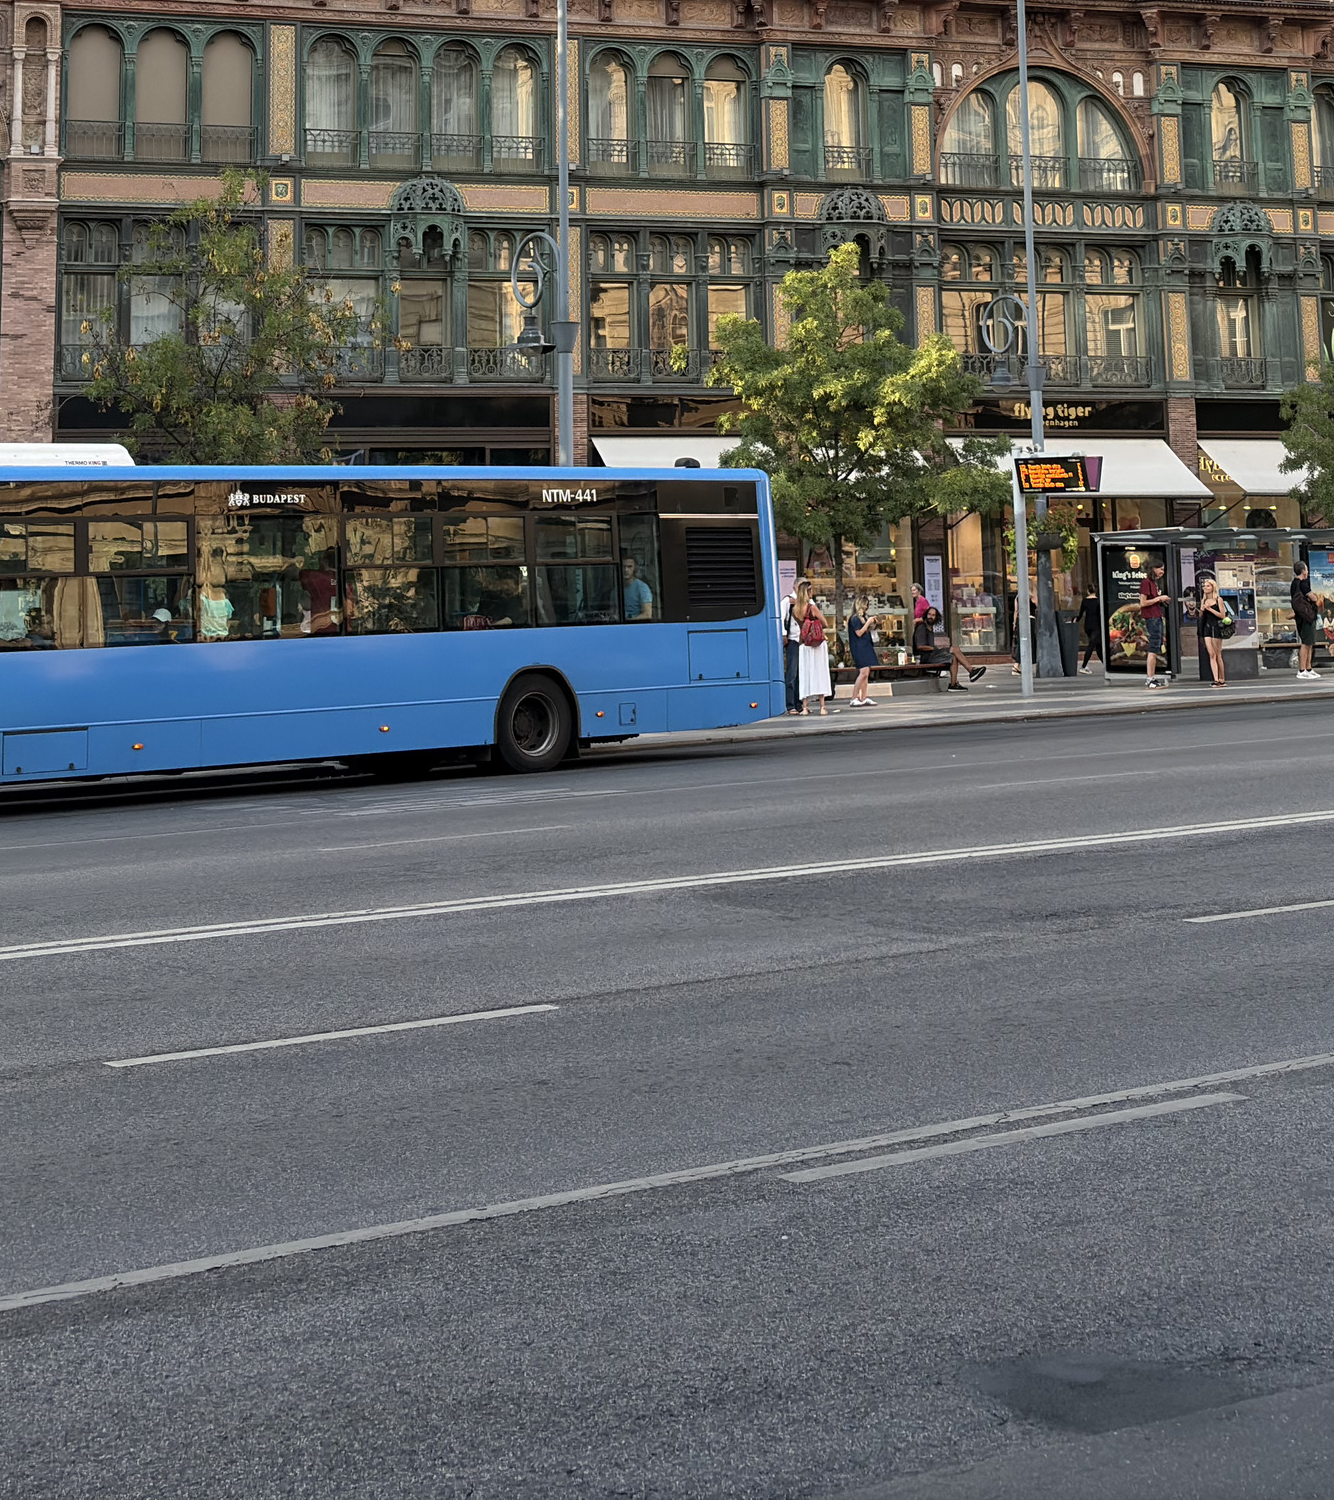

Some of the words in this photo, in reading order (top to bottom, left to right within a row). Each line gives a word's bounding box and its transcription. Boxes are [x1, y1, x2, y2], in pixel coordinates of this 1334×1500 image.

[1056, 403, 1092, 419] tiger
[252, 493, 306, 504] BUDAPEST
[541, 489, 598, 503] NTM-441
